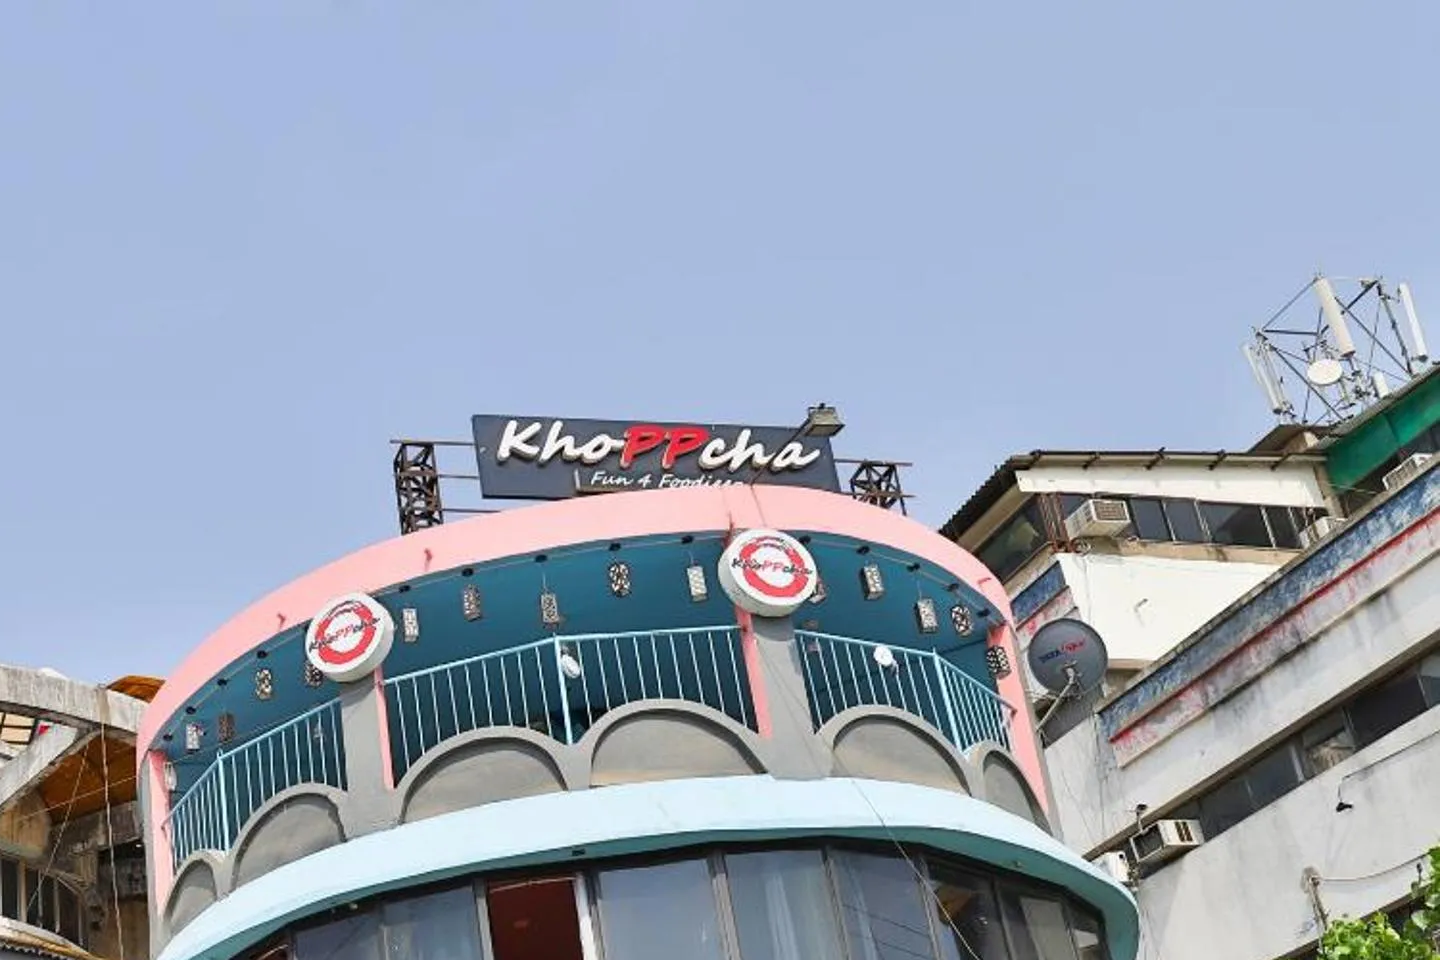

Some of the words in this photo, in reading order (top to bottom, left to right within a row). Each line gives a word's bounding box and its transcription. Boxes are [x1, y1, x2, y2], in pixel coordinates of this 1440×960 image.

[497, 420, 821, 470] KhoPPcha
[590, 471, 633, 487] Fun
[637, 474, 652, 486] 4
